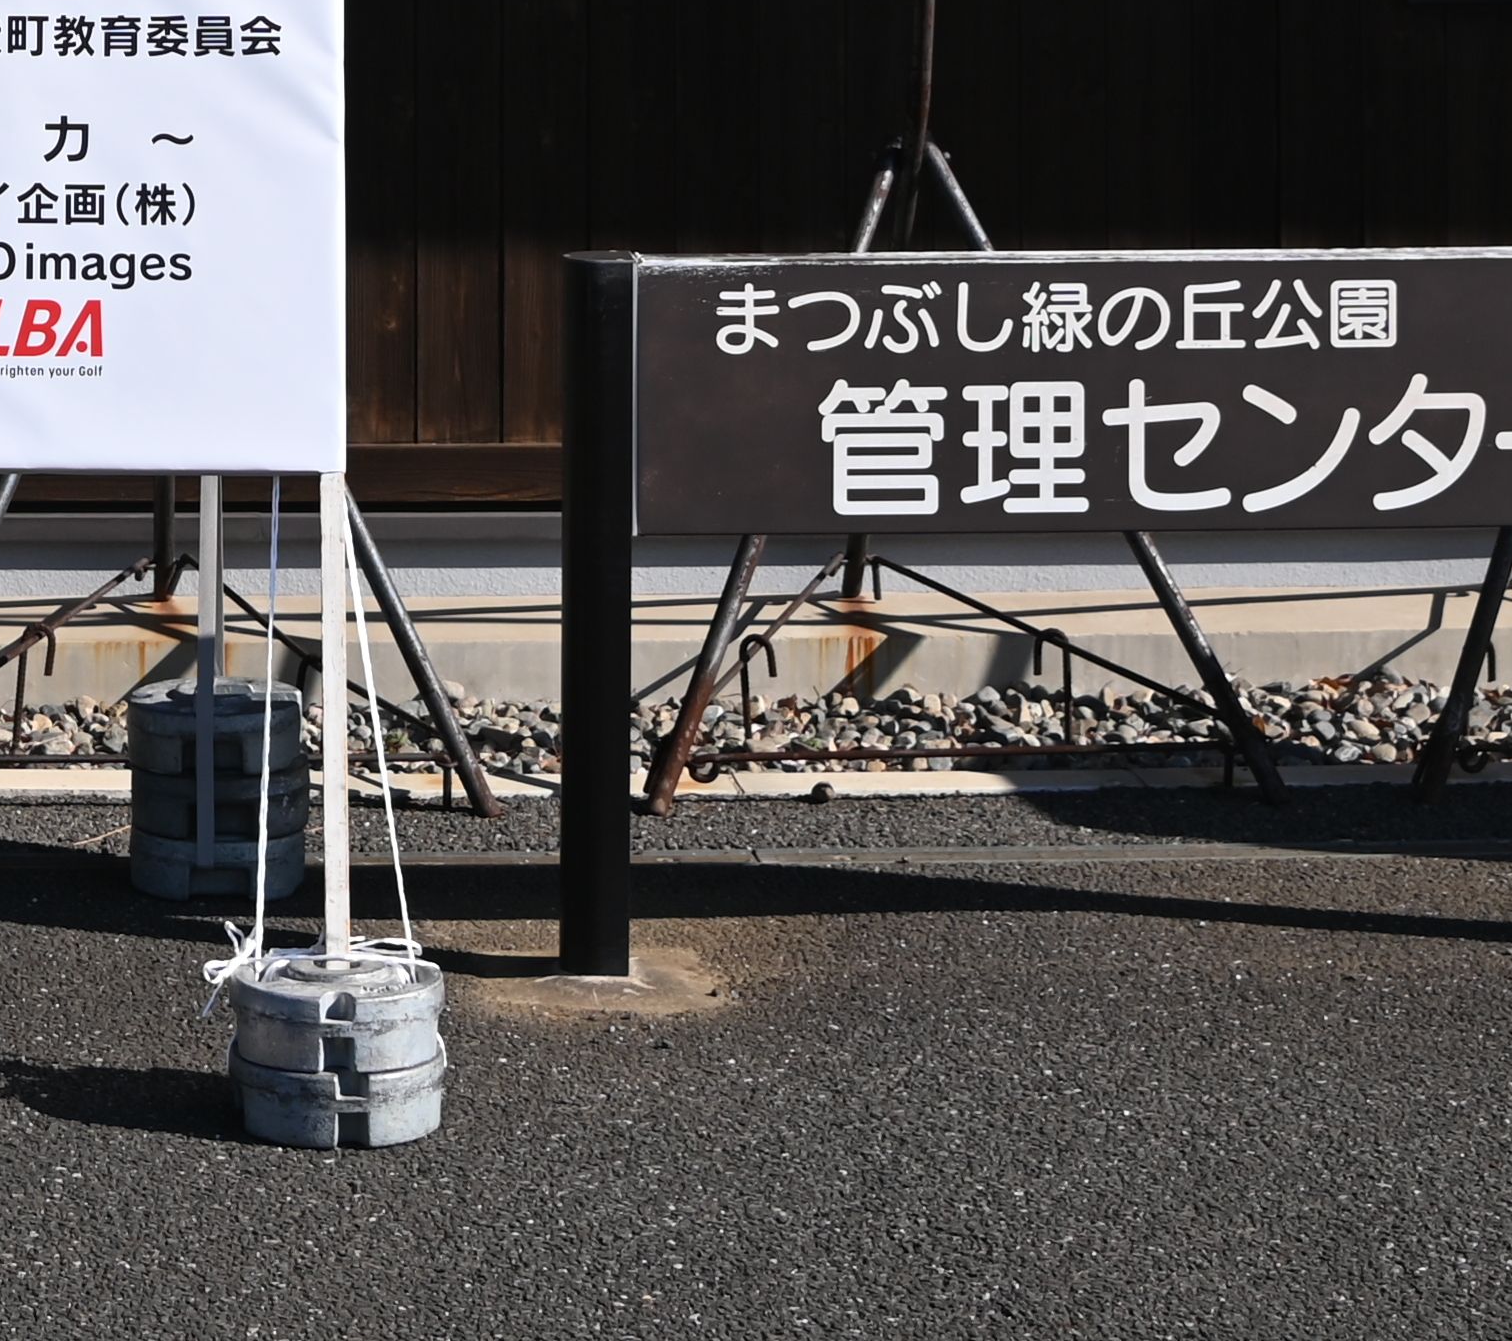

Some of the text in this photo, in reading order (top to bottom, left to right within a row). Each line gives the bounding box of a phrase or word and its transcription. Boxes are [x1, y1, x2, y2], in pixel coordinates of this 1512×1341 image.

[714, 278, 1399, 355] まつぶし緑の丘公園
[48, 366, 76, 379] your
[78, 364, 103, 377] Golf
